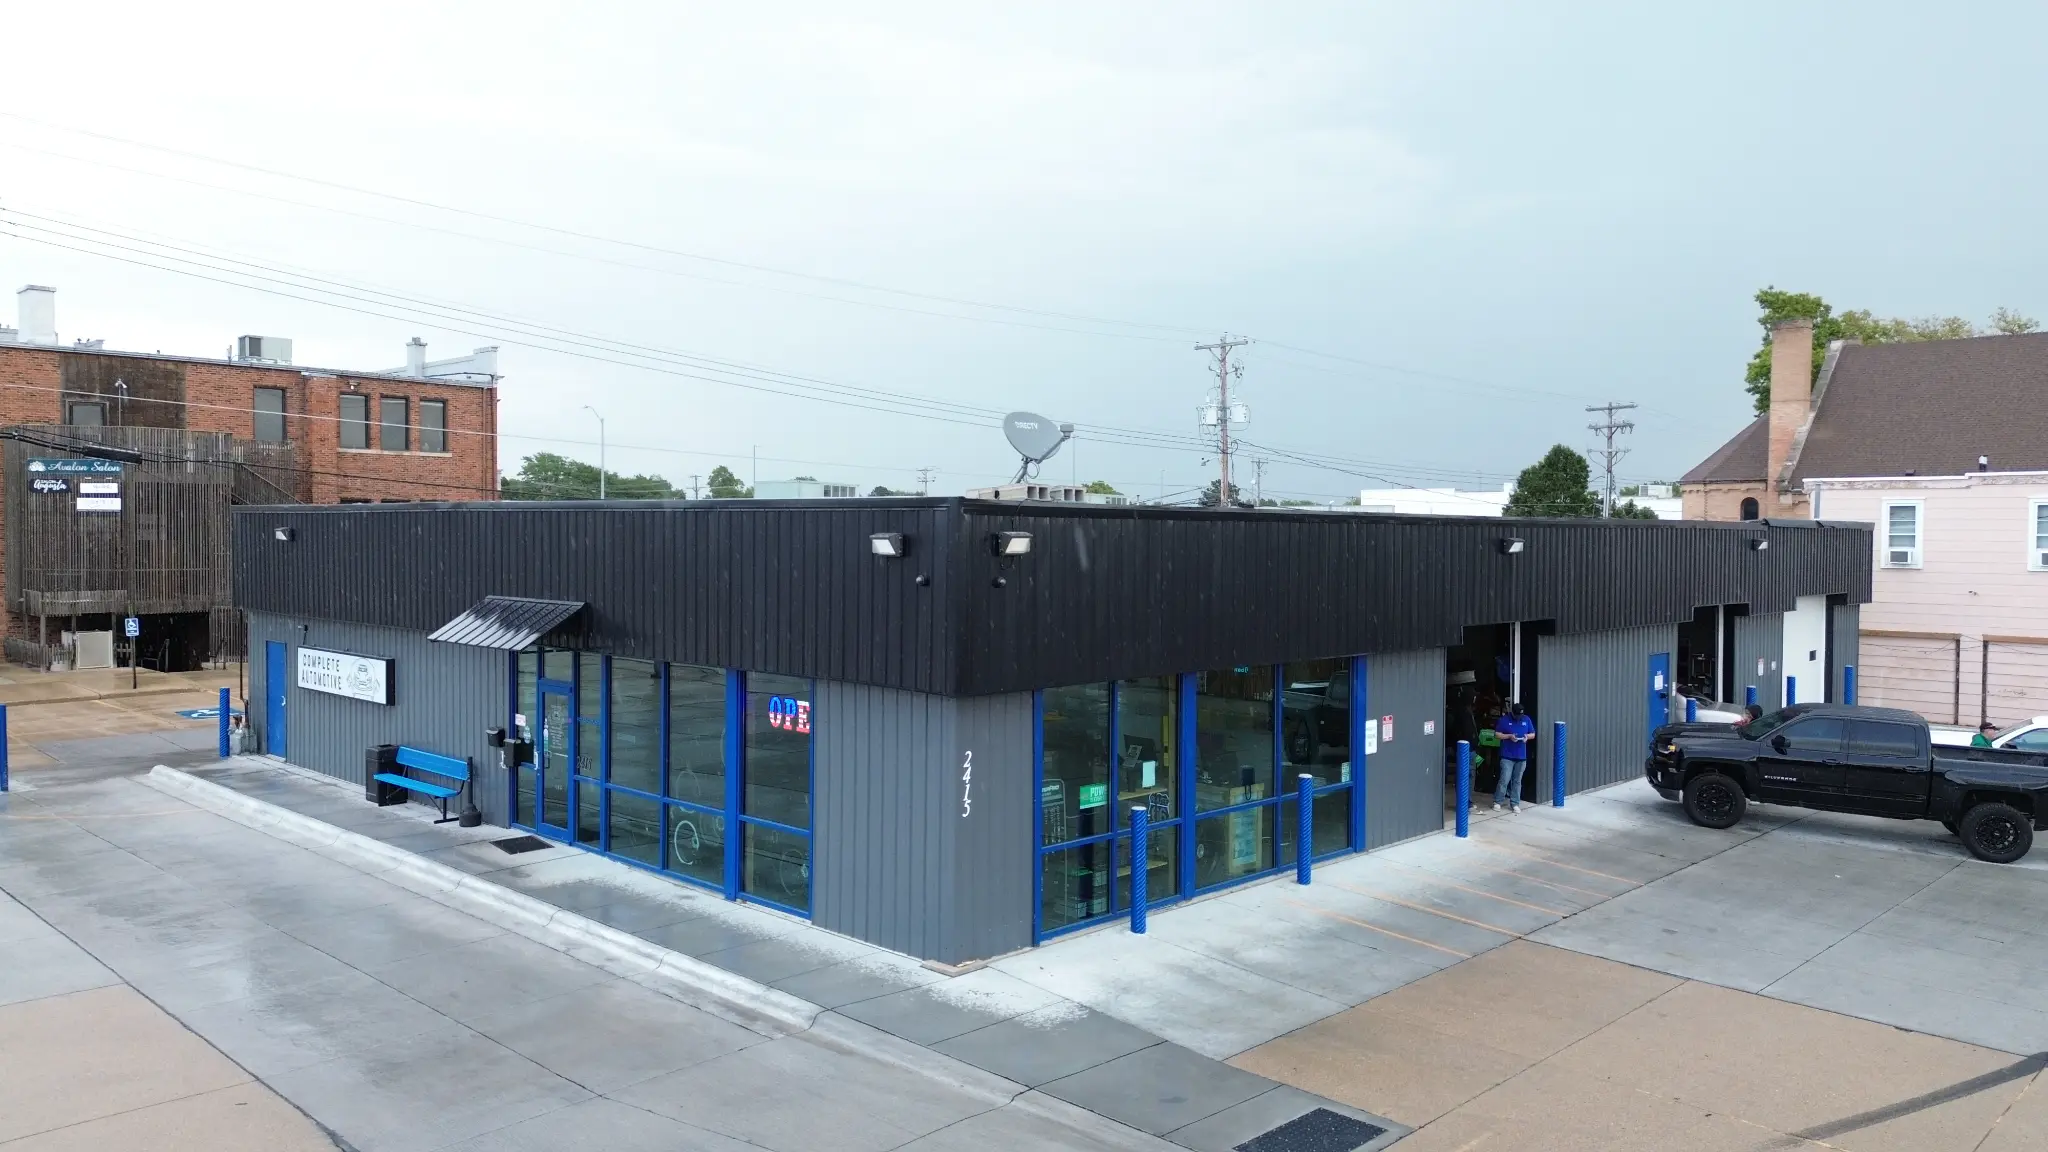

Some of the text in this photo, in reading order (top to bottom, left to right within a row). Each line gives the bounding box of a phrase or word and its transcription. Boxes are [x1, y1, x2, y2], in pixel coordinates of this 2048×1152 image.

[47, 461, 121, 472] Avalon Salon
[33, 479, 68, 493] Augusta
[302, 653, 340, 672] COMPLETE
[301, 669, 342, 691] AUTOMOTIVE
[962, 750, 973, 818] 2415
